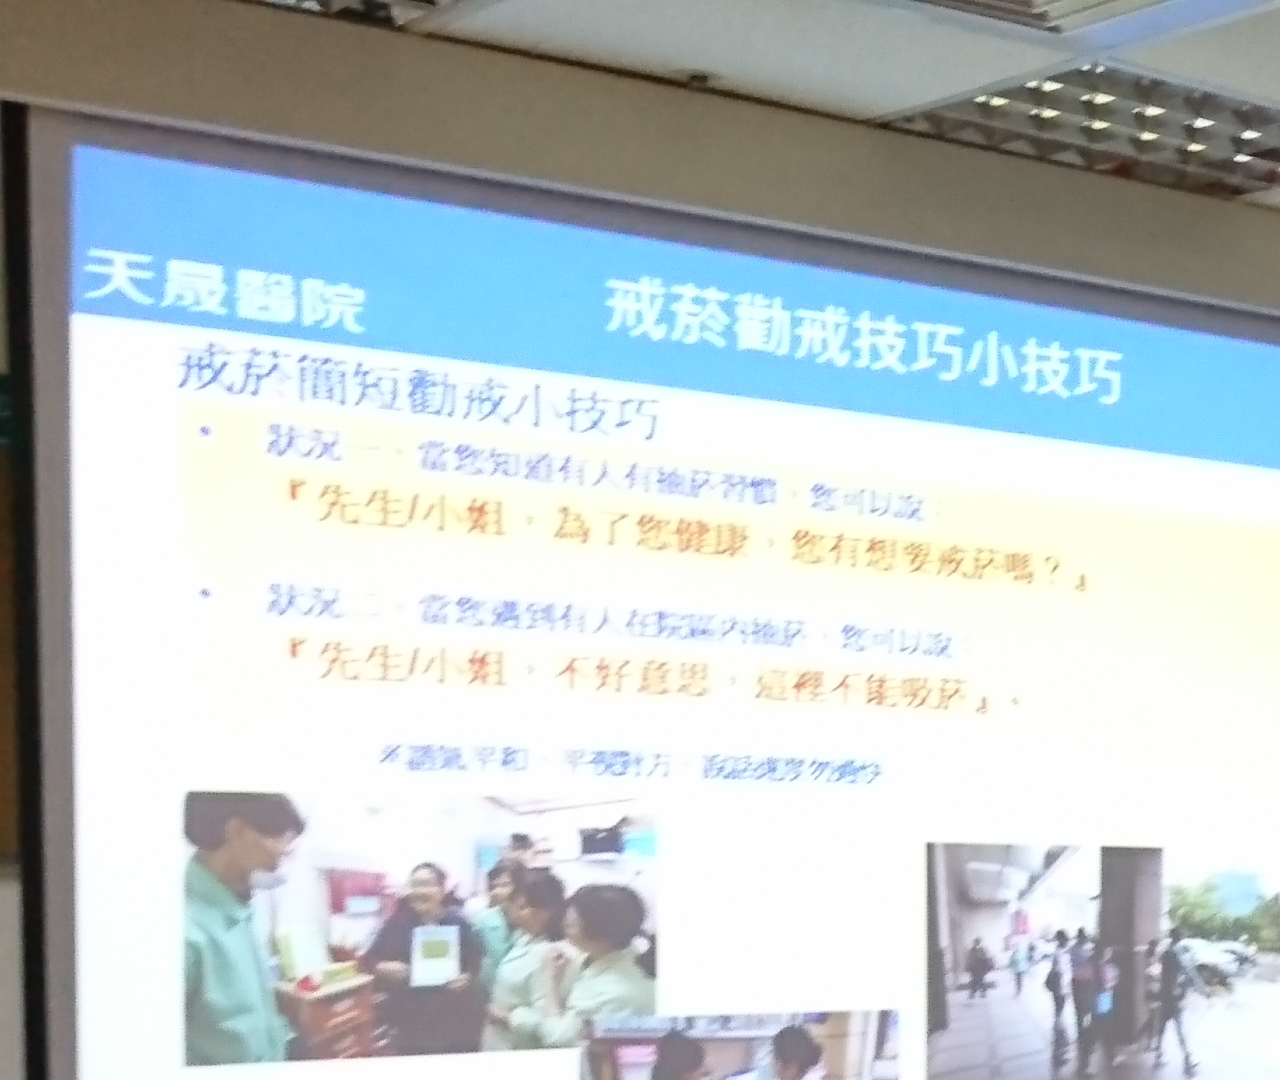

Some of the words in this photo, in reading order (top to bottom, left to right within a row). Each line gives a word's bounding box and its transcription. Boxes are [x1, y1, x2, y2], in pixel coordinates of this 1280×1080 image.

[84, 248, 367, 335] 天晟醫院
[605, 276, 1123, 404] 戒菸勸戒技巧小技巧
[178, 341, 661, 441] 戒菸簡短勸戒小技巧
